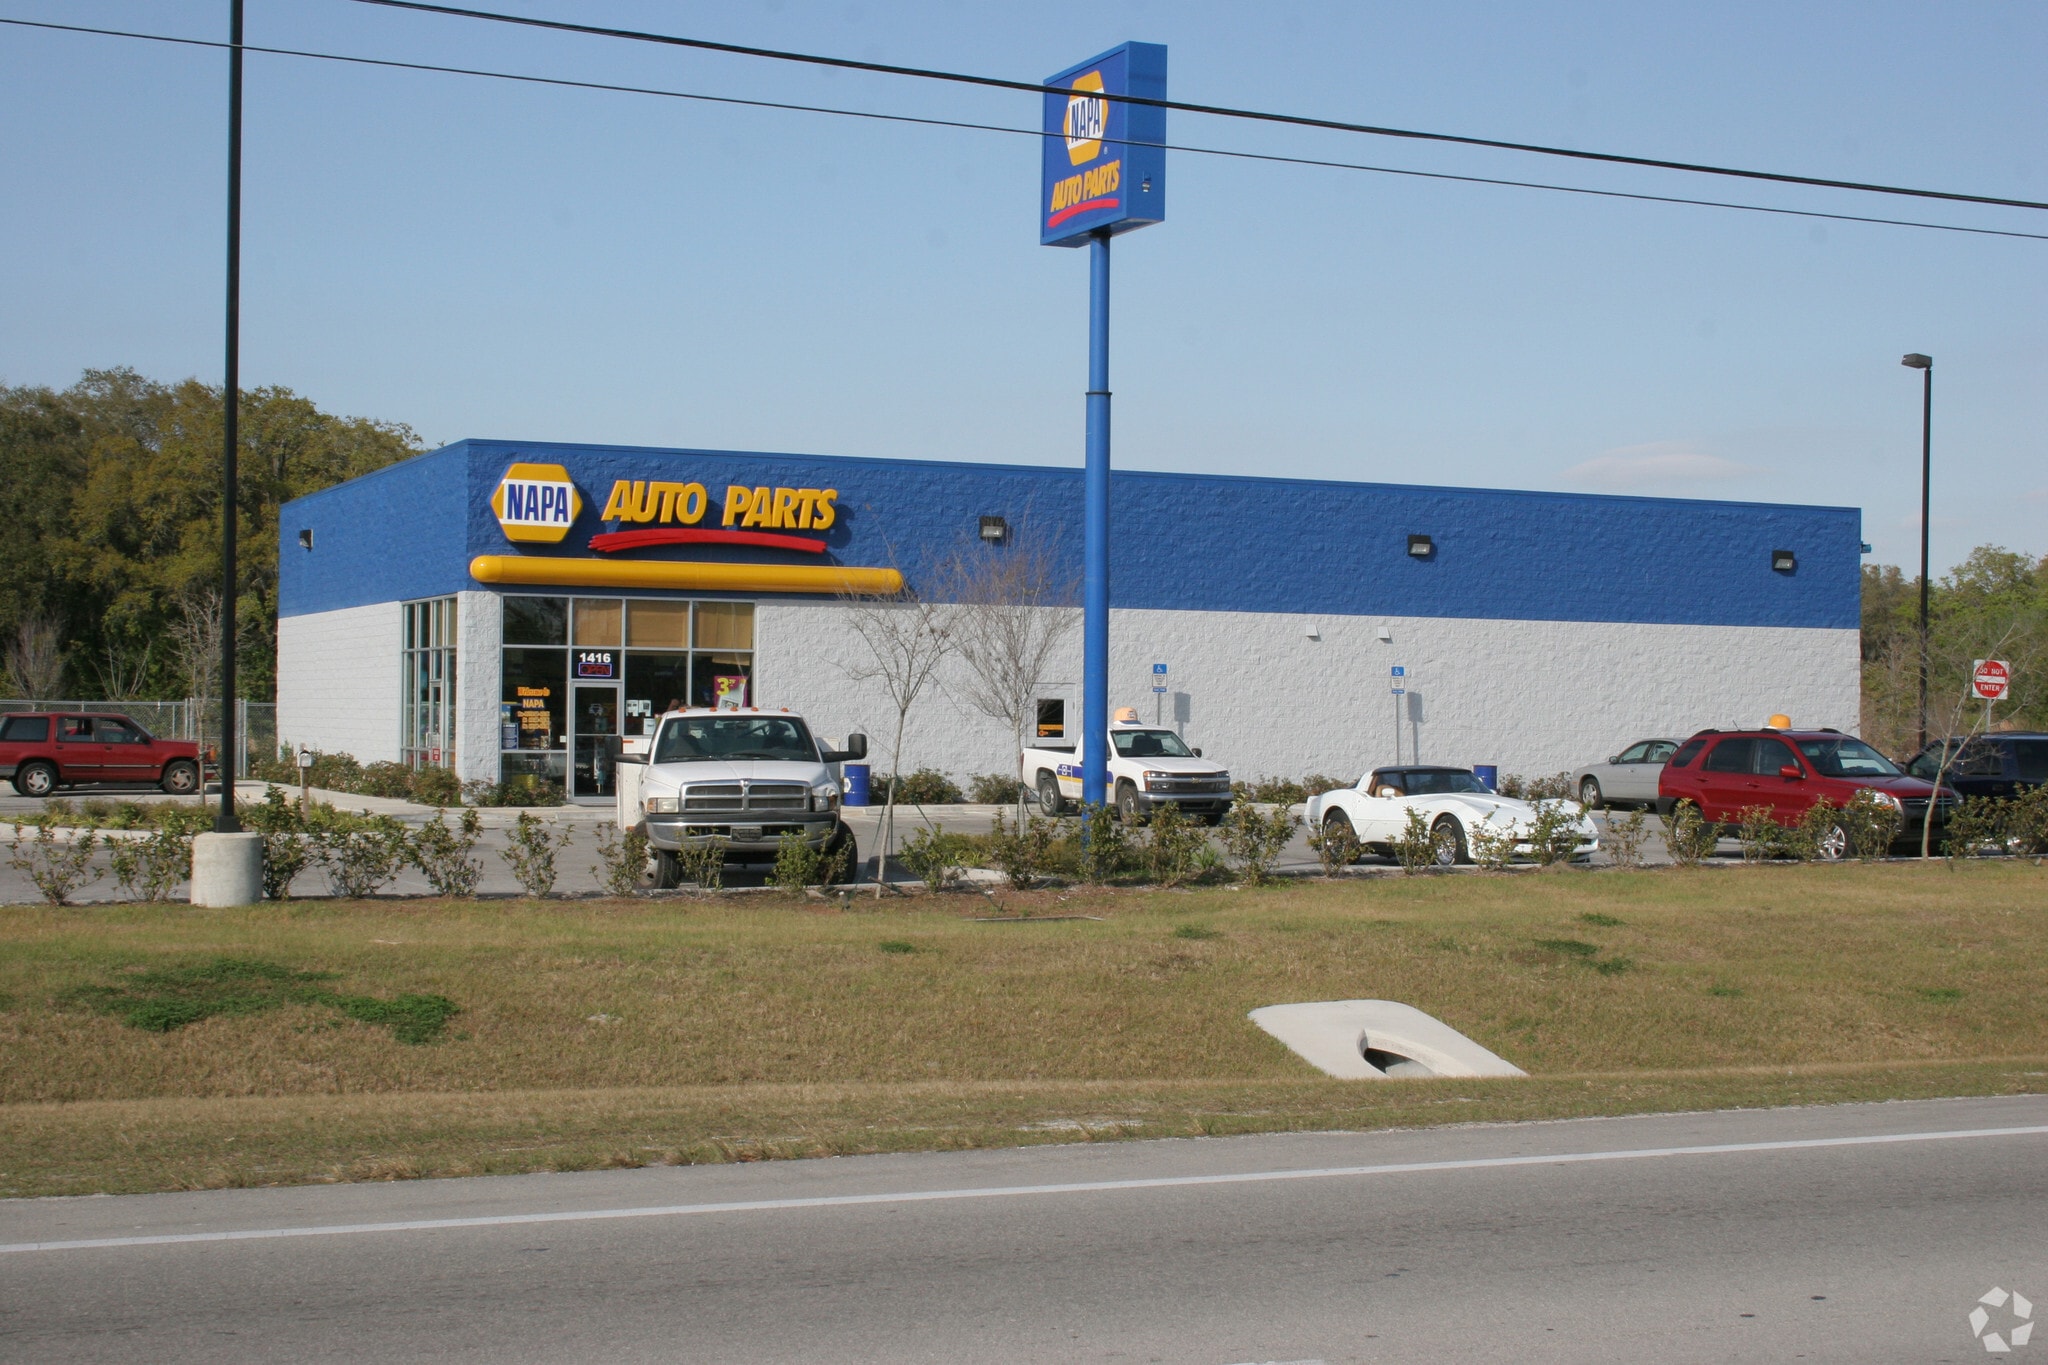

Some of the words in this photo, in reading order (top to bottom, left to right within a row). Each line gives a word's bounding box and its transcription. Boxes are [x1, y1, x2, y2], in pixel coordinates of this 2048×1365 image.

[1071, 98, 1101, 143] NAPA
[1051, 175, 1082, 212] AUTO
[1083, 160, 1120, 200] PARTS
[507, 483, 569, 523] NAPA
[601, 479, 708, 525] AUTO
[722, 485, 838, 531] PARTS
[579, 652, 611, 663] 1416
[582, 665, 609, 674] OPEN
[522, 698, 545, 708] NAPA
